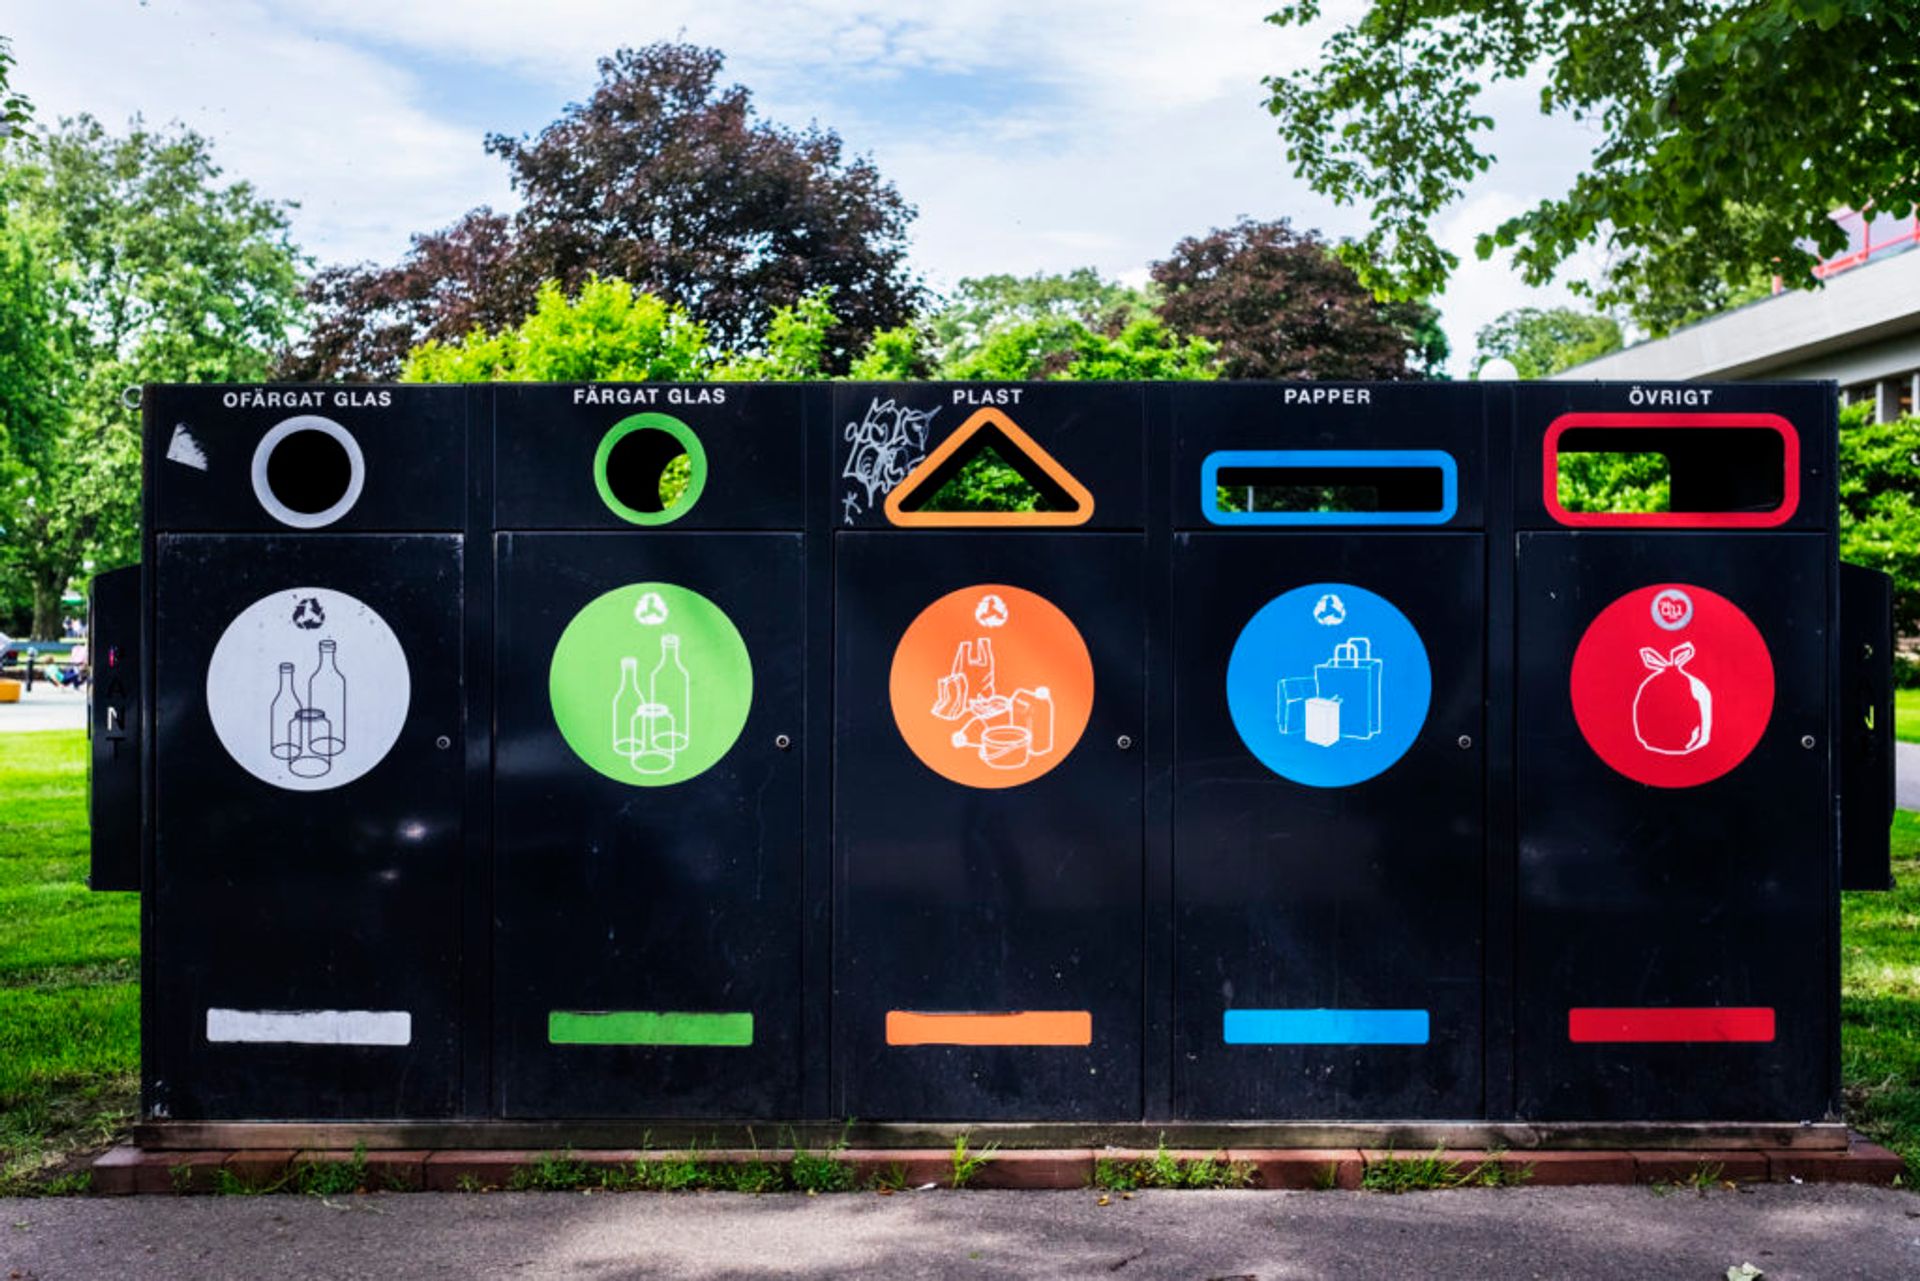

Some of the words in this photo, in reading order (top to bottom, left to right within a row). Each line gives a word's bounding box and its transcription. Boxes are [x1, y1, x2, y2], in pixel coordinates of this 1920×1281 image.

[223, 388, 326, 408] OFÄRGAT
[333, 388, 392, 408] GLAS
[573, 385, 659, 406] FÄRGAT
[667, 386, 726, 405] GLAS
[952, 388, 1023, 405] PLAST
[1284, 388, 1371, 405] PAPPER
[1628, 385, 1713, 406] ÖVRIGT
